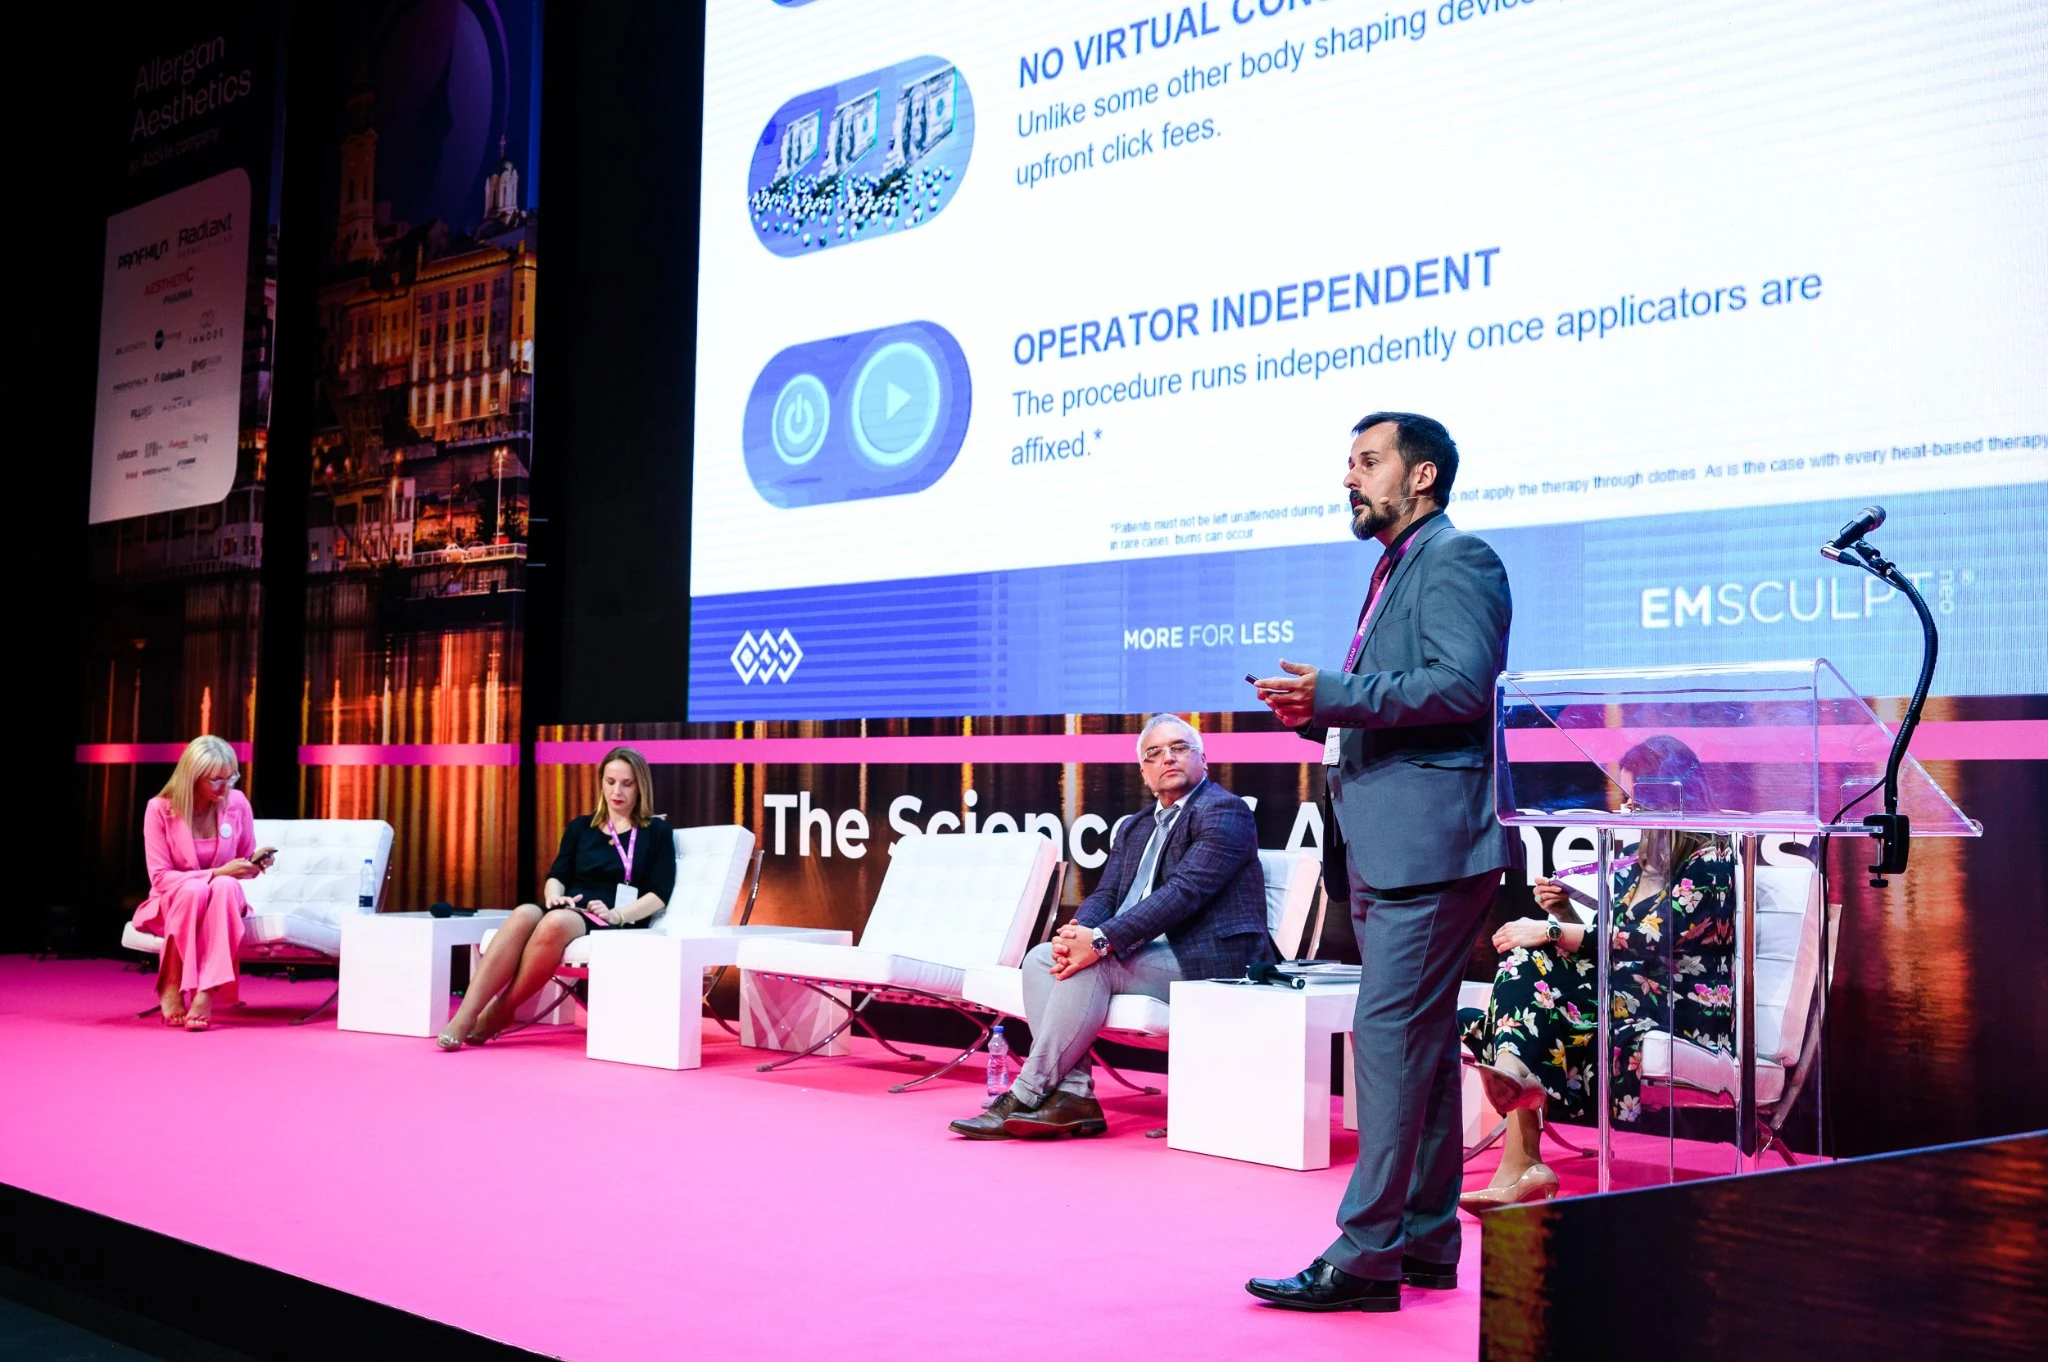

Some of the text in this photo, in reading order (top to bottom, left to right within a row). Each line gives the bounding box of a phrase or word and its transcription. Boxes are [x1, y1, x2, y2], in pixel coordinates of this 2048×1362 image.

[133, 36, 225, 100] Allergan
[1018, 102, 1086, 137] Unlike
[1094, 83, 1158, 117] some
[1168, 65, 1232, 97] other
[1241, 40, 1304, 78] body
[1315, 9, 1426, 58] shaping
[1019, 47, 1064, 88] NO
[1074, 2, 1220, 71] VIRTUAL
[130, 69, 252, 143] Aesthetics
[1016, 118, 1221, 189] upfront click fees.
[1014, 247, 1500, 366] OPERATOR INDEPENDENT
[1012, 273, 1822, 417] The procedure runs independently once applicators are
[1460, 488, 1479, 500] not
[1483, 484, 1514, 501] apply
[1519, 482, 1538, 496] the
[1542, 477, 1589, 494] therapy
[1594, 474, 1643, 489] through
[1705, 464, 1722, 478] As
[1727, 463, 1738, 476] is
[1743, 460, 1766, 474] the
[1770, 457, 1804, 472] case
[1809, 453, 1840, 468] with
[1845, 449, 1887, 465] every
[1892, 438, 1983, 460] heat-based
[1111, 540, 1118, 550] in
[1121, 538, 1139, 549] rare
[1205, 530, 1222, 542] can
[1180, 516, 1195, 527] not
[1198, 514, 1210, 525] be
[1291, 504, 1324, 518] during
[1123, 620, 1294, 650] MORE FOR LESS
[764, 791, 870, 859] The
